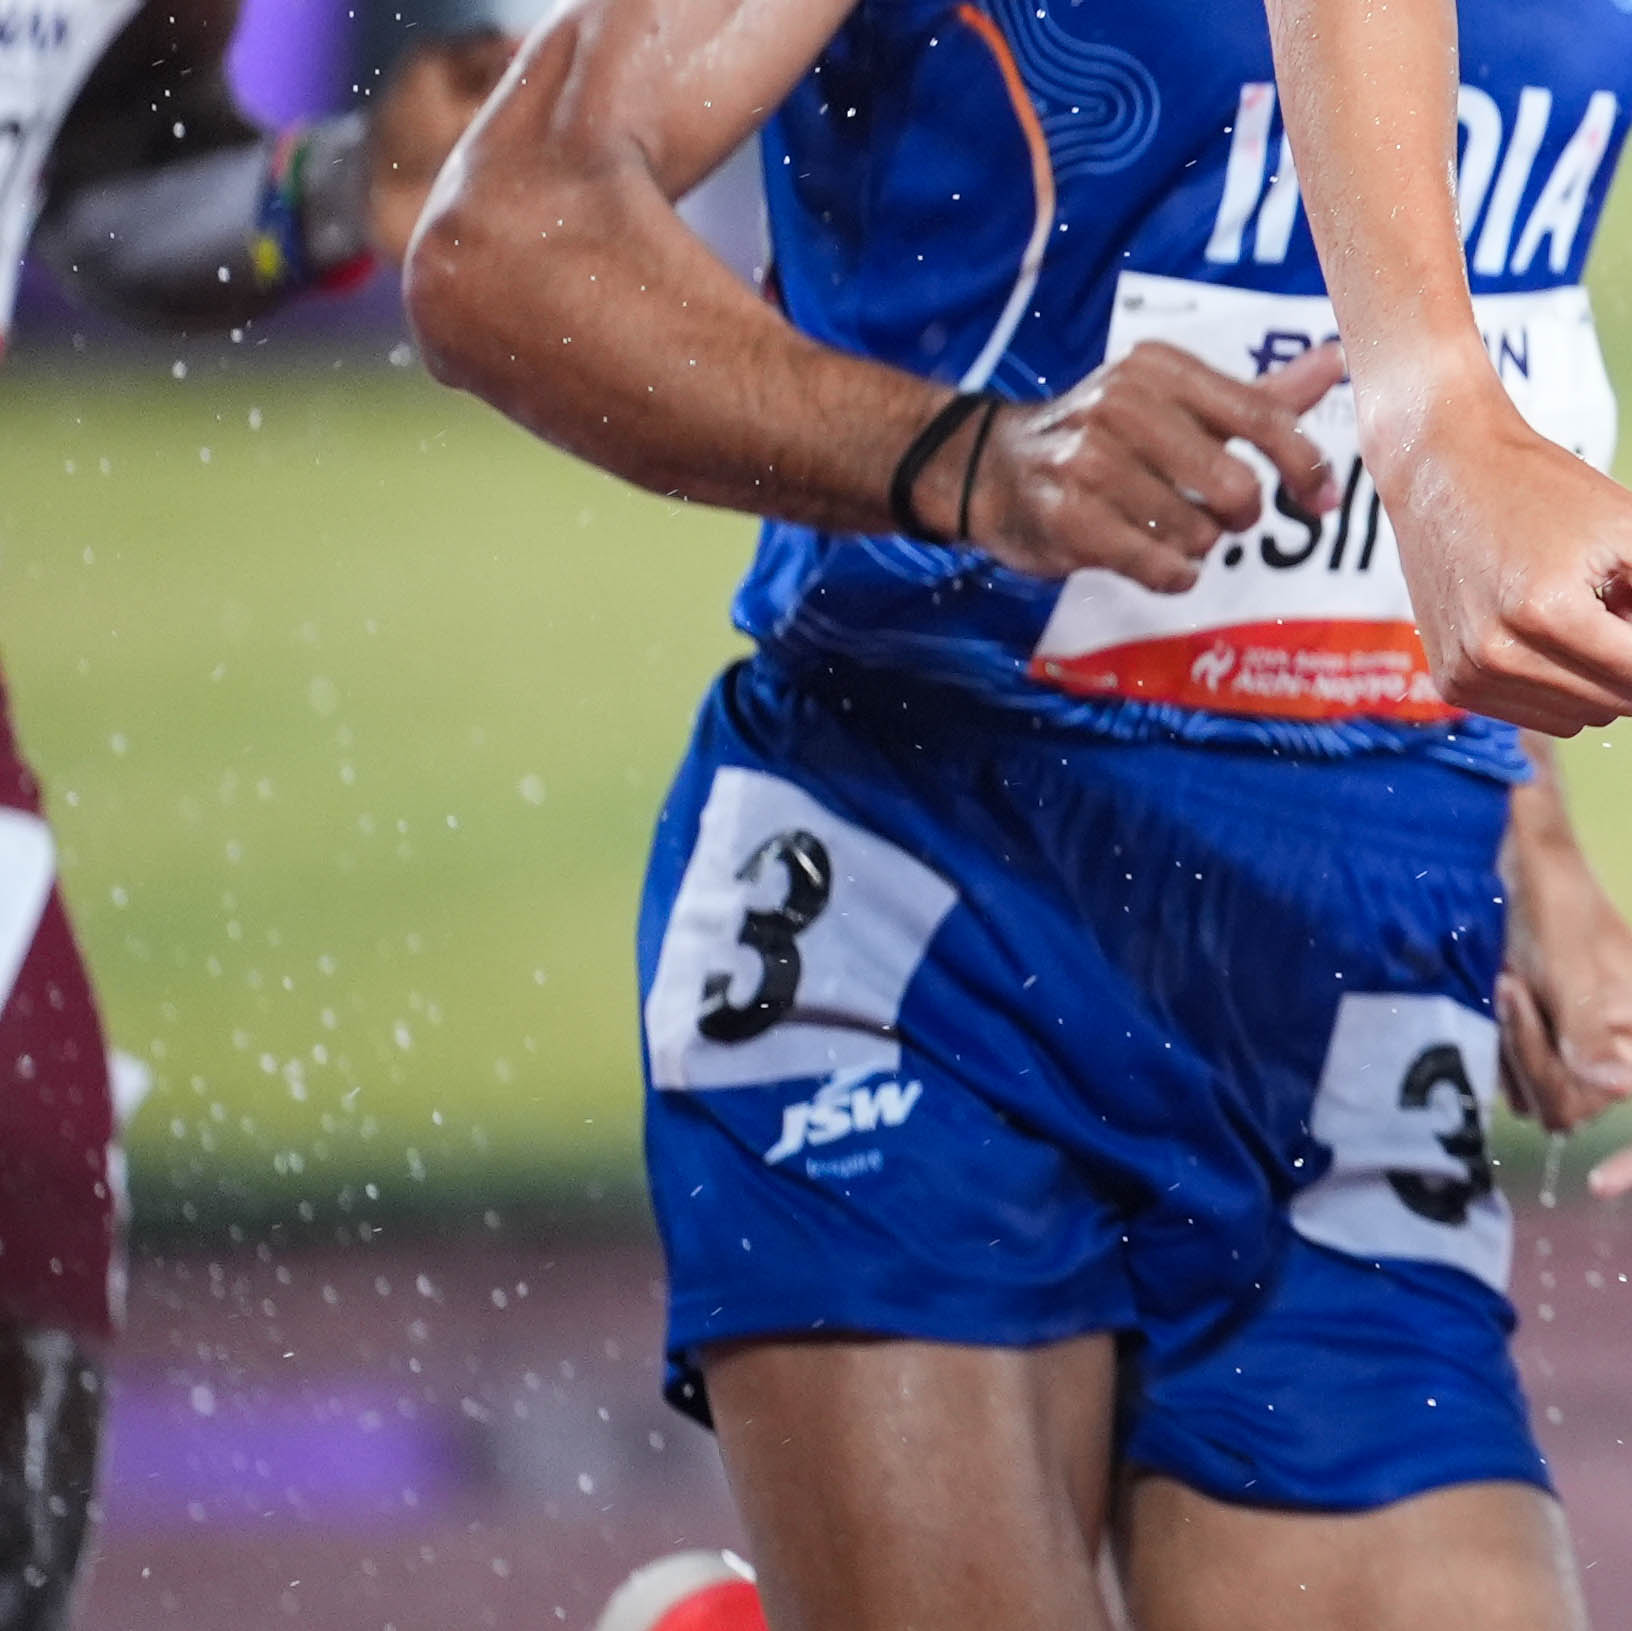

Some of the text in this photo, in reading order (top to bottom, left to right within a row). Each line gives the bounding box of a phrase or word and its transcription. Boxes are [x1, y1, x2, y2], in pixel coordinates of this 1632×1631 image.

[700, 829, 833, 1043] 3
[763, 1079, 924, 1165] JSW
[1388, 1044, 1493, 1225] 3
